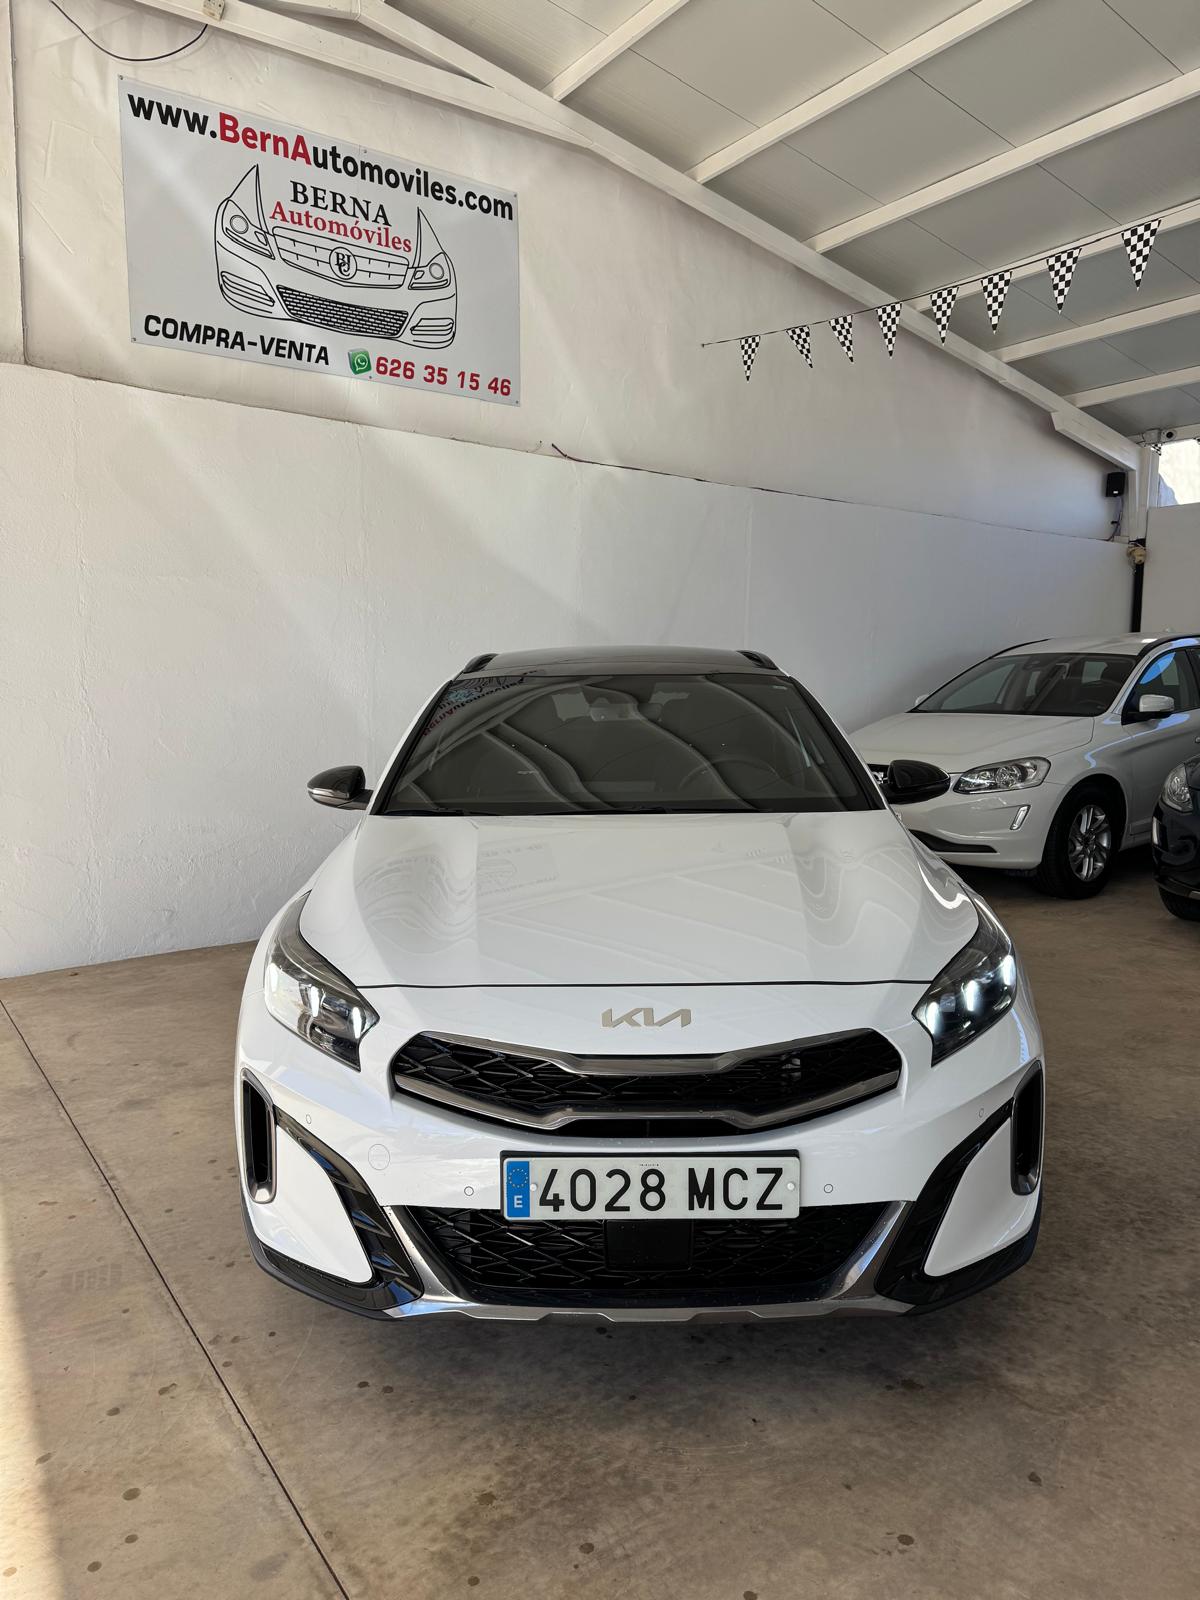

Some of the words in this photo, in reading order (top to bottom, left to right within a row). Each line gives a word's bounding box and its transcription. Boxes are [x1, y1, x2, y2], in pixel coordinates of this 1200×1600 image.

[127, 93, 513, 221] www.BernAutomoviles.com
[290, 180, 392, 227] BERNA
[269, 201, 412, 253] Automóviles
[144, 314, 329, 365] COMPRA-VENTA
[375, 356, 415, 380] 626
[423, 364, 448, 385] 35
[457, 371, 480, 391] 15
[488, 377, 511, 397] 46
[601, 1007, 692, 1028] KIA
[513, 1195, 523, 1208] E
[539, 1168, 666, 1213] 4028
[688, 1167, 784, 1211] MCZ
